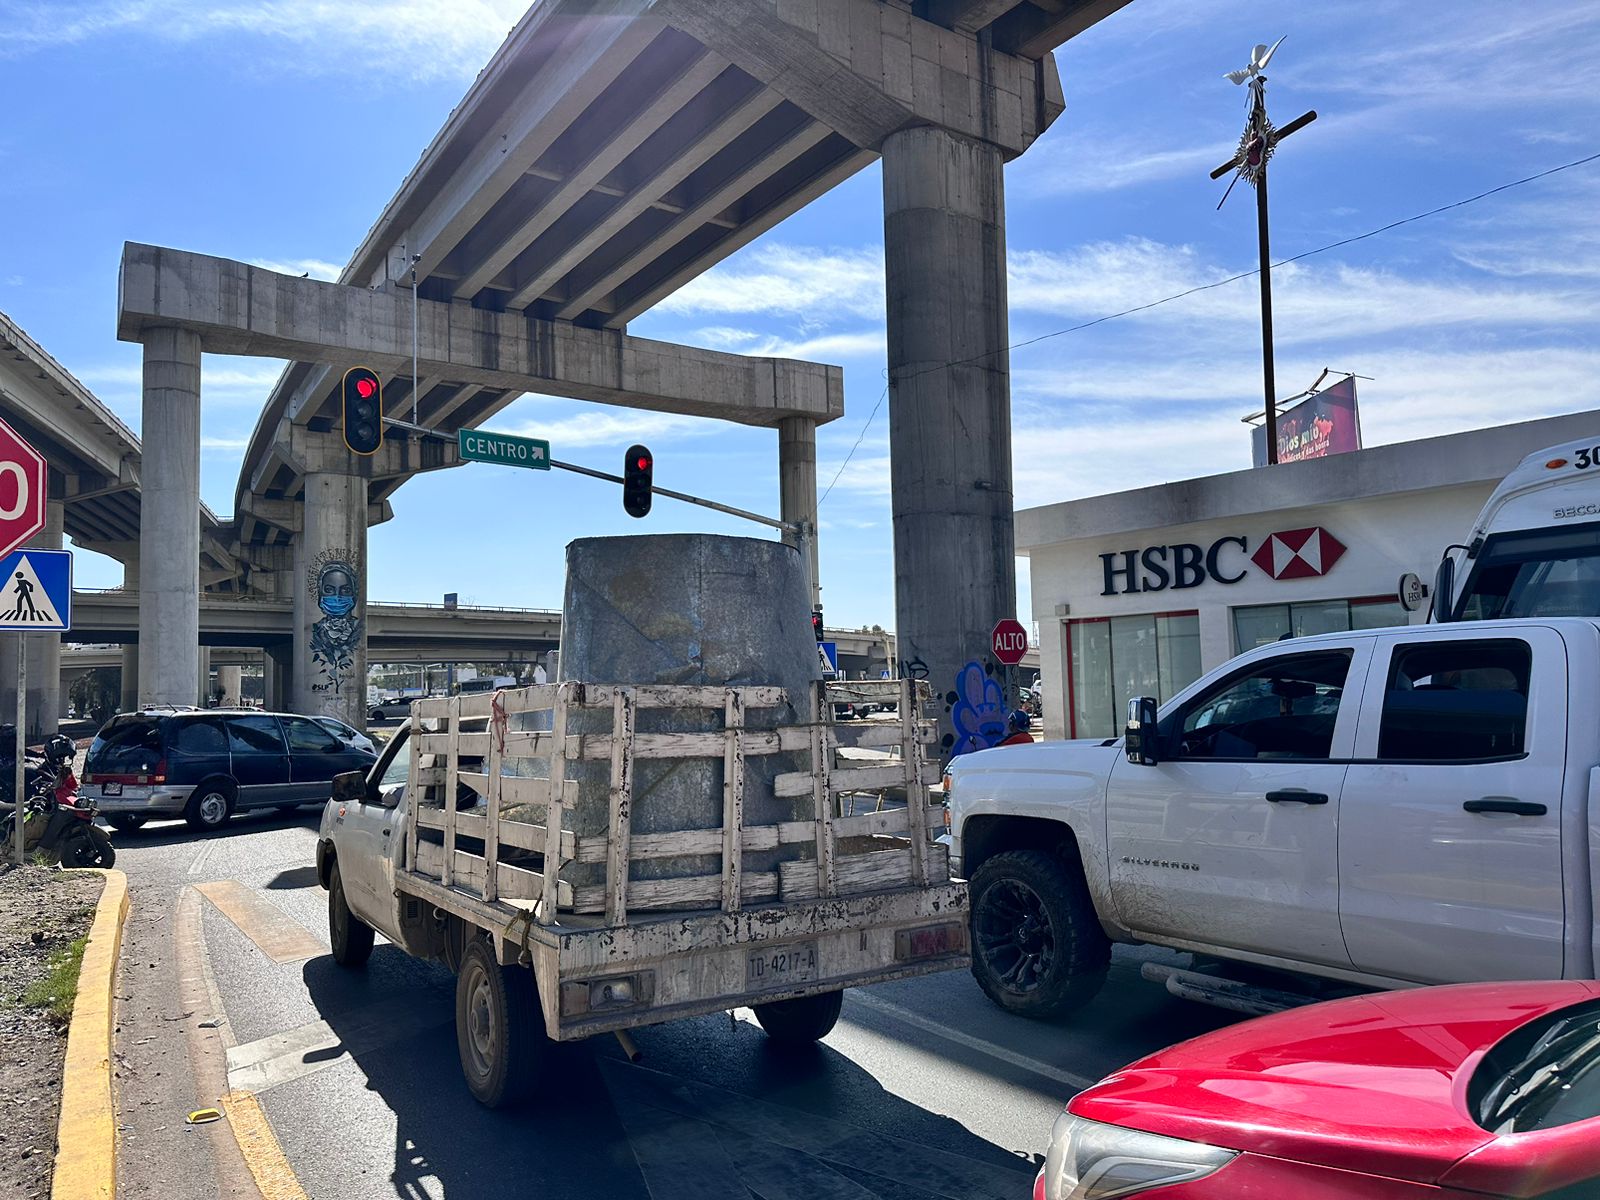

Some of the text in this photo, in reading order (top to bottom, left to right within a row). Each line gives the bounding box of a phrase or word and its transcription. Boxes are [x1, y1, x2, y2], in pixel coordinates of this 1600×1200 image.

[466, 437, 527, 460] CENTRO
[1279, 436, 1299, 454] Dios
[1553, 504, 1600, 519] BECC
[1099, 536, 1248, 596] HSBC
[995, 632, 1025, 651] ALTO
[750, 950, 815, 977] TD-4217-A
